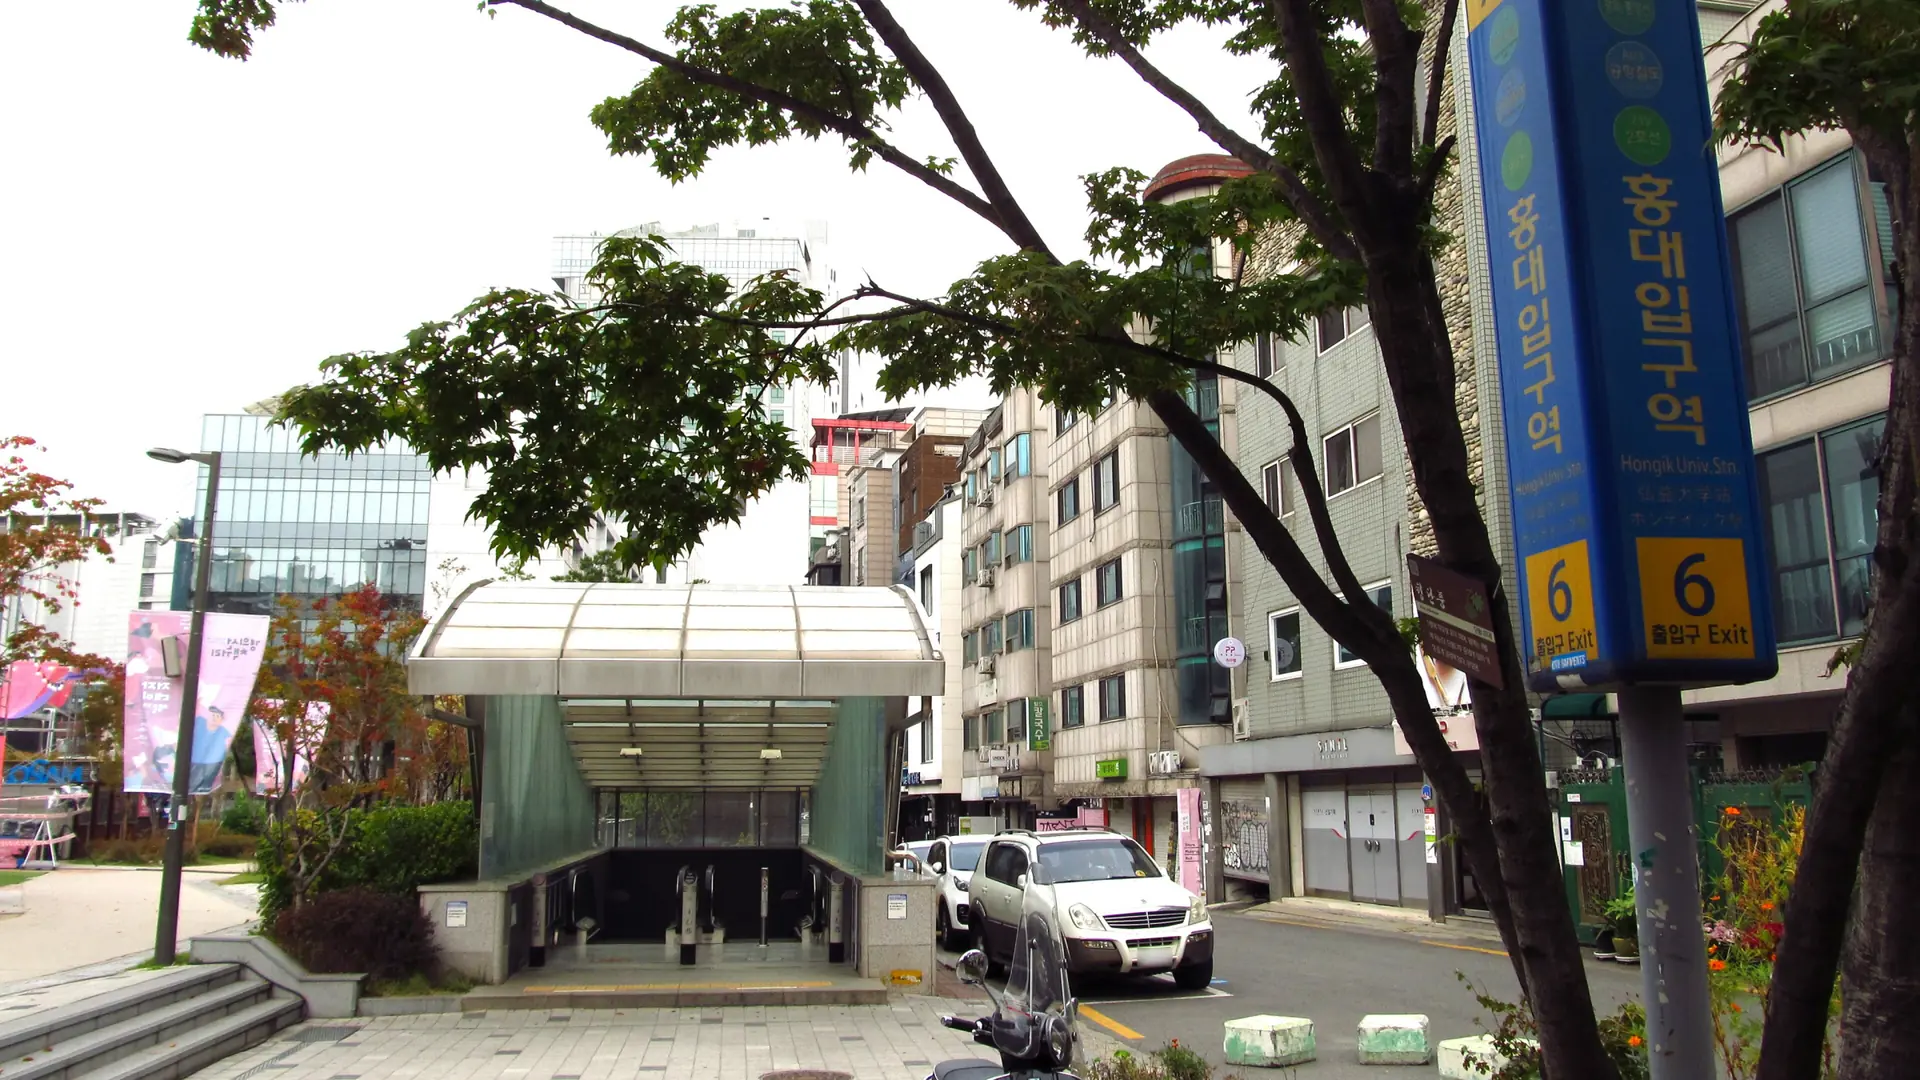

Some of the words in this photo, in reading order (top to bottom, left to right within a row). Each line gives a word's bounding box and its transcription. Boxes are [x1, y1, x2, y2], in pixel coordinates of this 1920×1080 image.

[1508, 193, 1563, 454] 홍대입구역
[1622, 173, 1707, 446] 홍대입구역
[1620, 454, 1675, 477] Hongik
[1676, 456, 1713, 475] Univ.
[1713, 456, 1740, 475] Stn.
[1547, 558, 1573, 622] 6
[1673, 553, 1716, 617] 6
[1536, 634, 1565, 657] 출입구
[1567, 628, 1594, 651] Exit
[1651, 624, 1701, 645] 출입구
[1708, 623, 1748, 645] Exit
